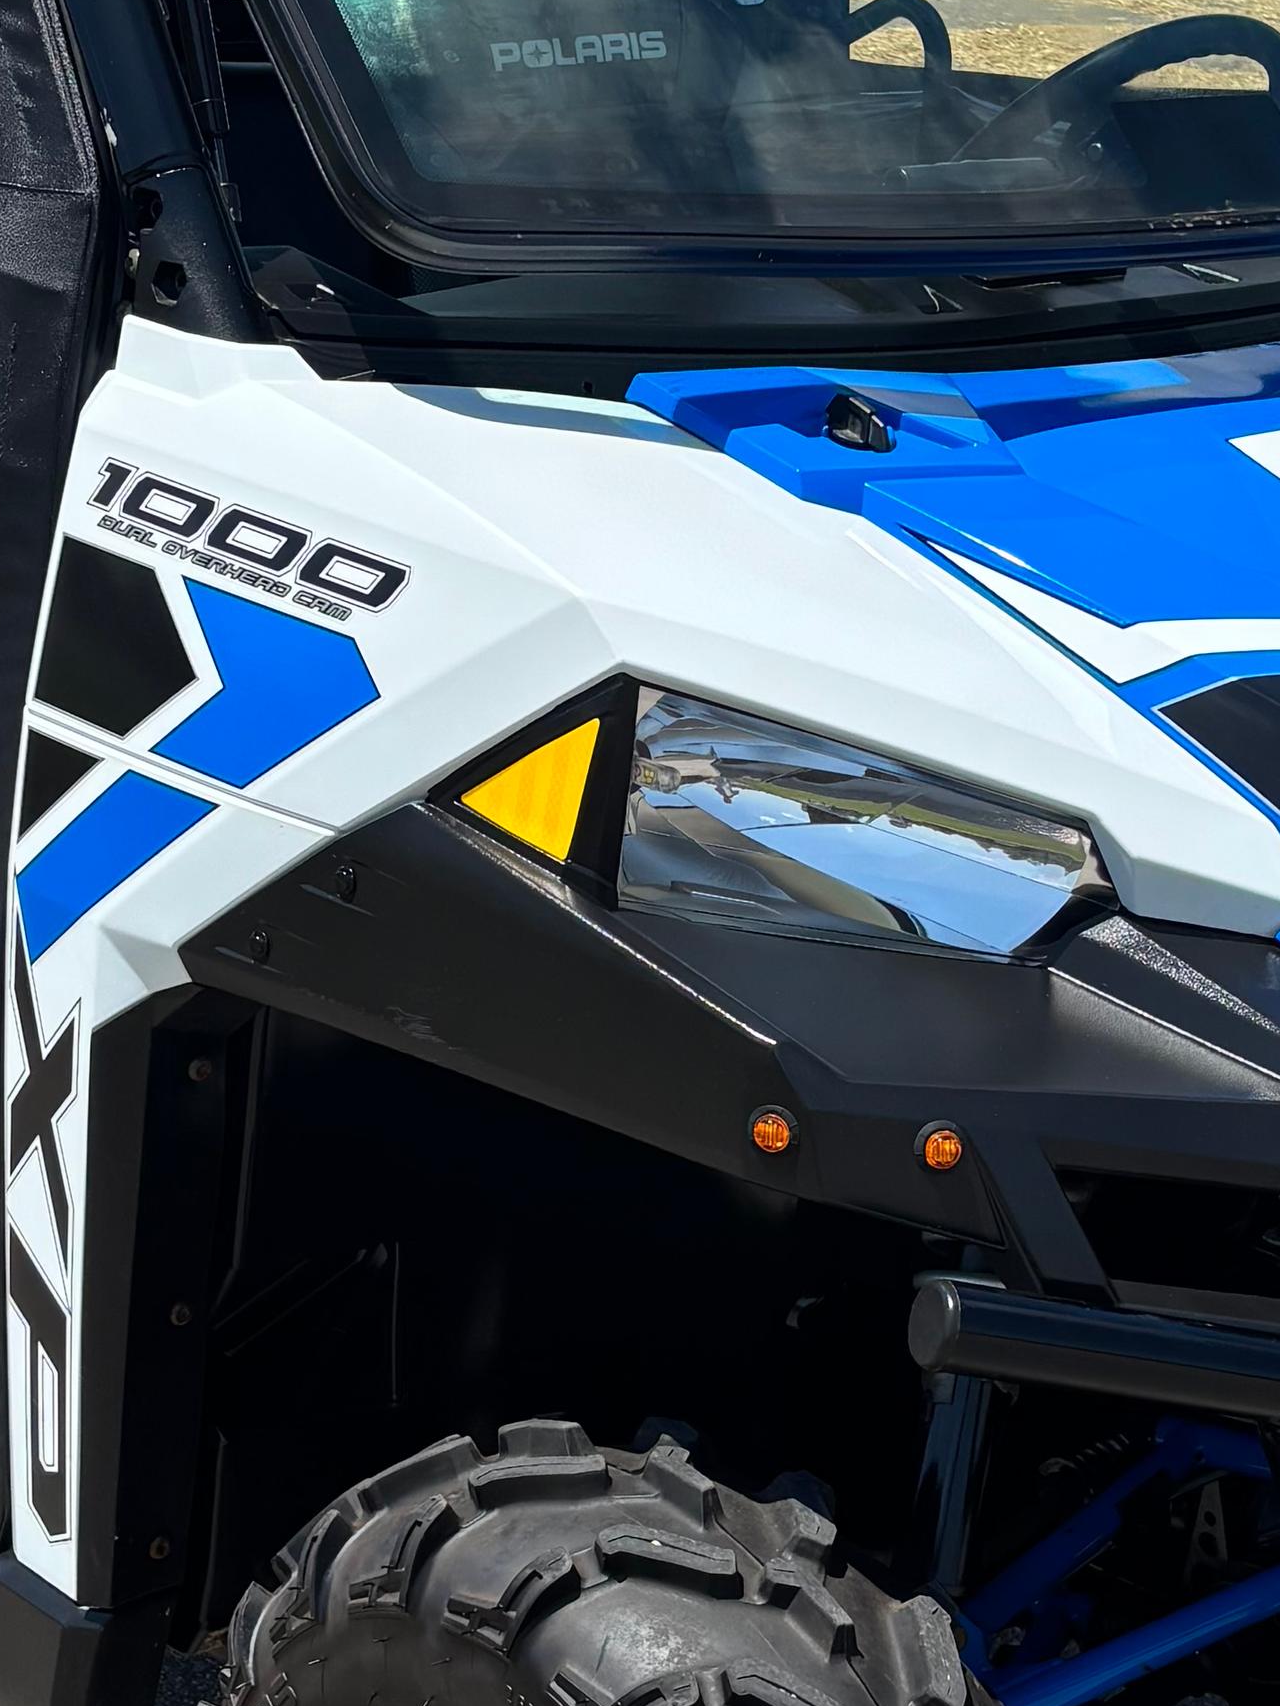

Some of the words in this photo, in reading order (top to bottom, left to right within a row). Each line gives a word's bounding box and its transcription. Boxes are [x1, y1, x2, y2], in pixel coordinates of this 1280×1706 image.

[490, 30, 667, 72] POLARIS
[87, 457, 412, 613] 1000
[97, 515, 157, 547] DUAL
[162, 540, 292, 597] OVERHEAD
[293, 592, 352, 621] CAM
